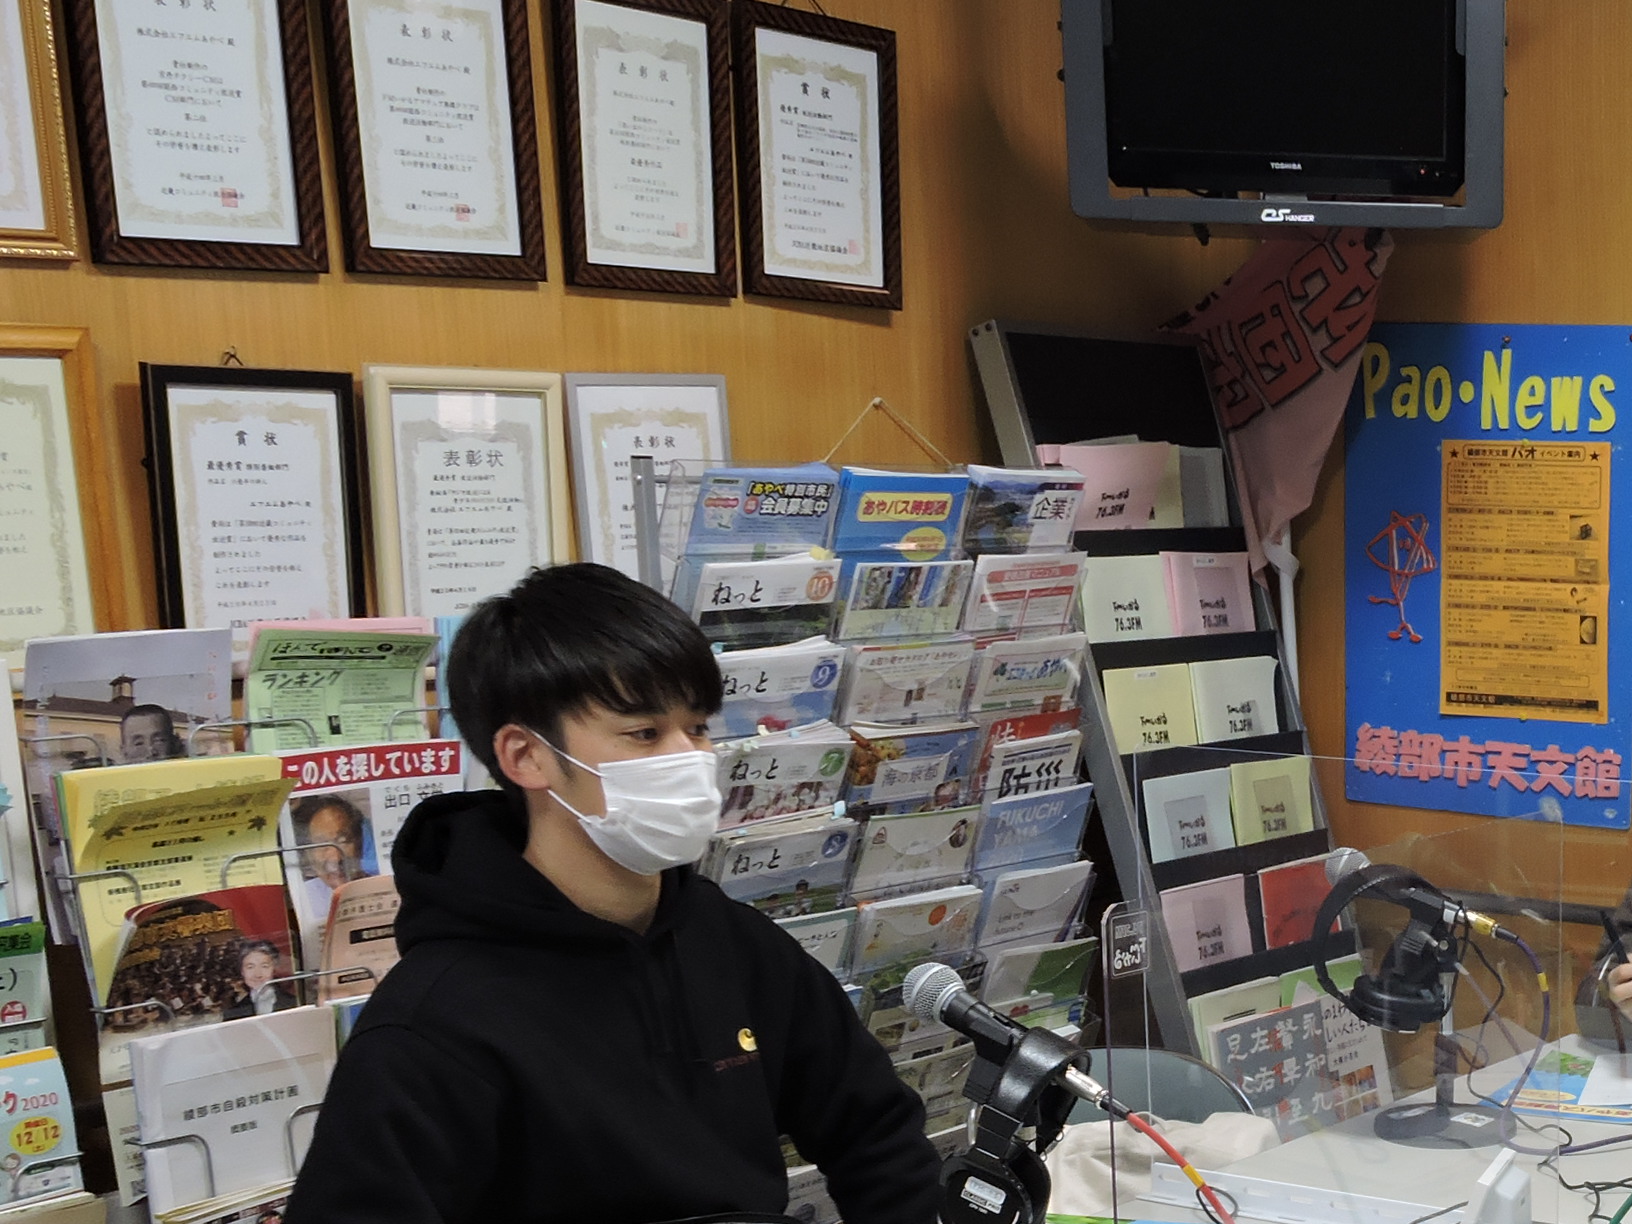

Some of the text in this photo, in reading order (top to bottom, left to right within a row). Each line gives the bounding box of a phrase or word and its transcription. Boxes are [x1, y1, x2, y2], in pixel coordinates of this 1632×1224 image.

[1270, 162, 1302, 171] TOSHIBA
[443, 450, 504, 468] 表彰状
[1511, 447, 1538, 459] パオ
[712, 579, 763, 606] ねっと
[729, 757, 779, 782] ねっと
[1353, 722, 1623, 800] 綾部市天文館
[731, 848, 781, 875] ねっと
[22, 1092, 58, 1111] 2020
[183, 1084, 300, 1122] 綾部市自殺対策計画
